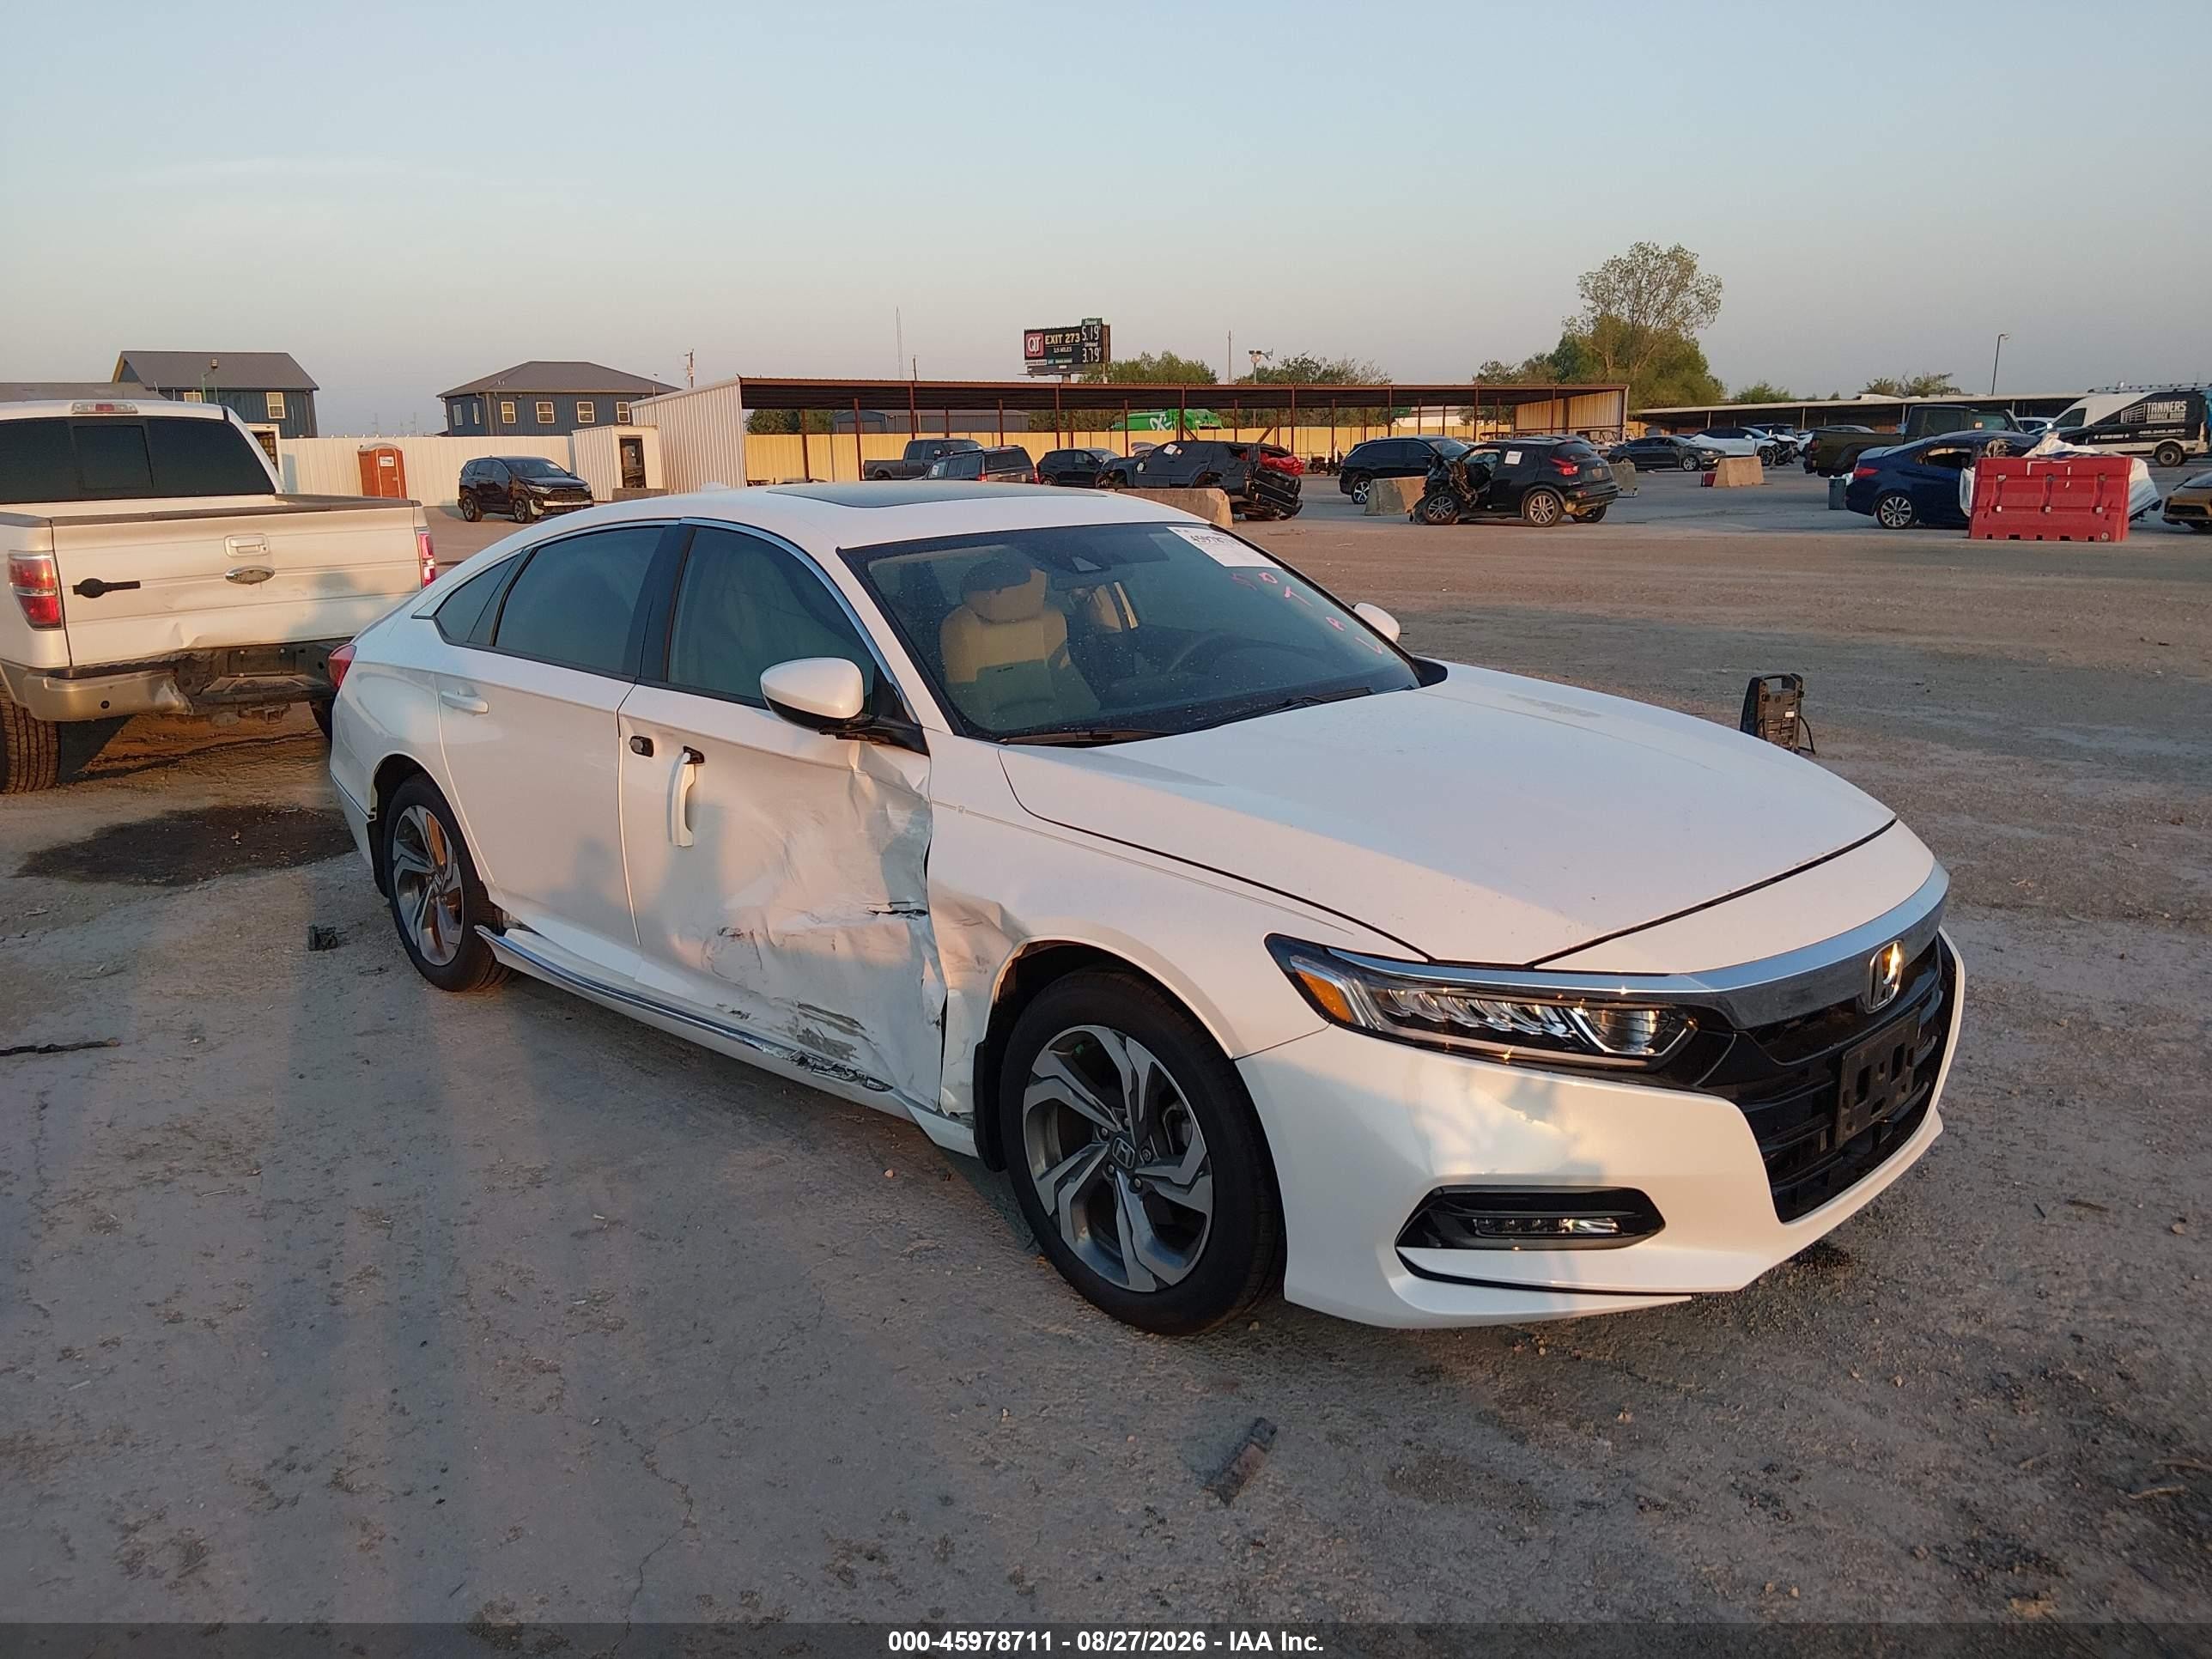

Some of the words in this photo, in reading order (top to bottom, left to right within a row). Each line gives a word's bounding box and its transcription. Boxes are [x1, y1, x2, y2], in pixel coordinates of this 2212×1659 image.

[1045, 334, 1063, 344] EXIT
[1065, 332, 1080, 343] 273
[1027, 336, 1041, 355] QT
[2146, 400, 2187, 413] TANNERS
